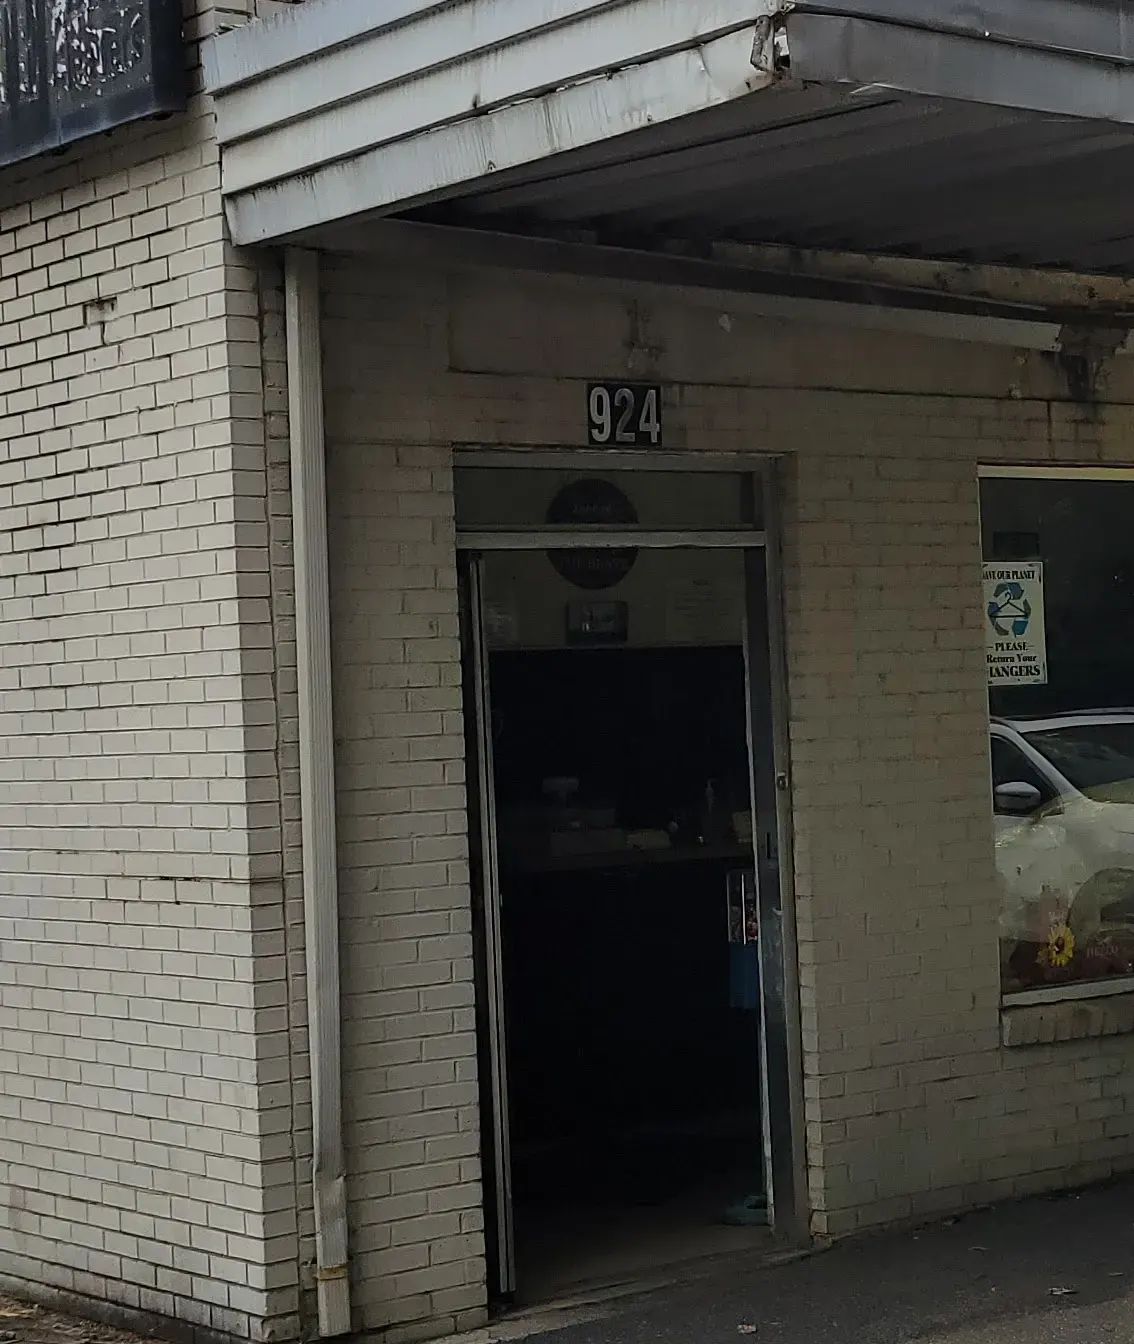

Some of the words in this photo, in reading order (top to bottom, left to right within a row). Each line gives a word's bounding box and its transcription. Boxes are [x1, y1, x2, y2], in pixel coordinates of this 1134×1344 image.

[590, 386, 660, 443] 924
[997, 570, 1011, 580] OUR
[1012, 570, 1036, 580] PLANET
[995, 642, 1029, 651] PLEASE
[987, 654, 1014, 663] Return
[1017, 653, 1037, 662] Your
